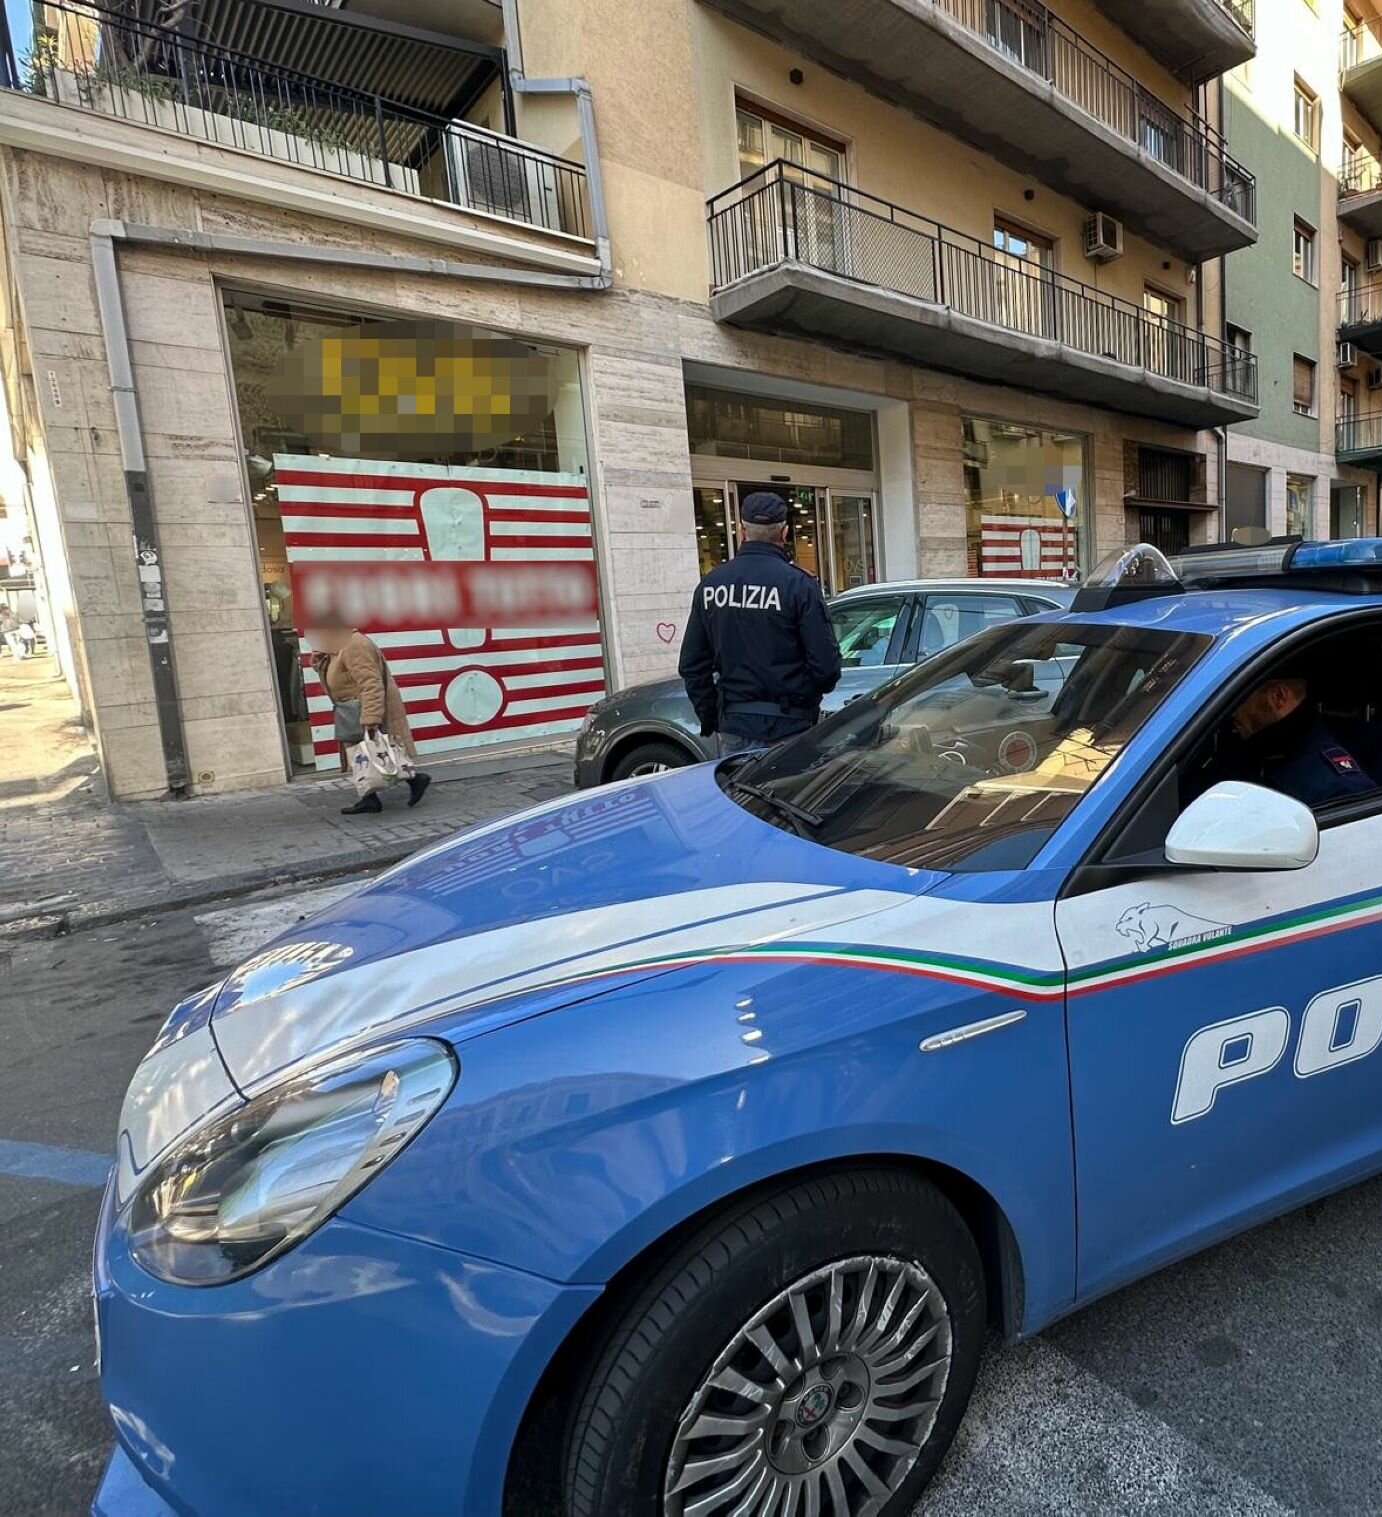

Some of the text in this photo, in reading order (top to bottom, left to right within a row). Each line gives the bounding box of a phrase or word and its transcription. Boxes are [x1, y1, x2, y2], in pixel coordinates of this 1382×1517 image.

[703, 584, 782, 611] POLIZIA
[1168, 927, 1232, 951] SQUADRA VOLANTE
